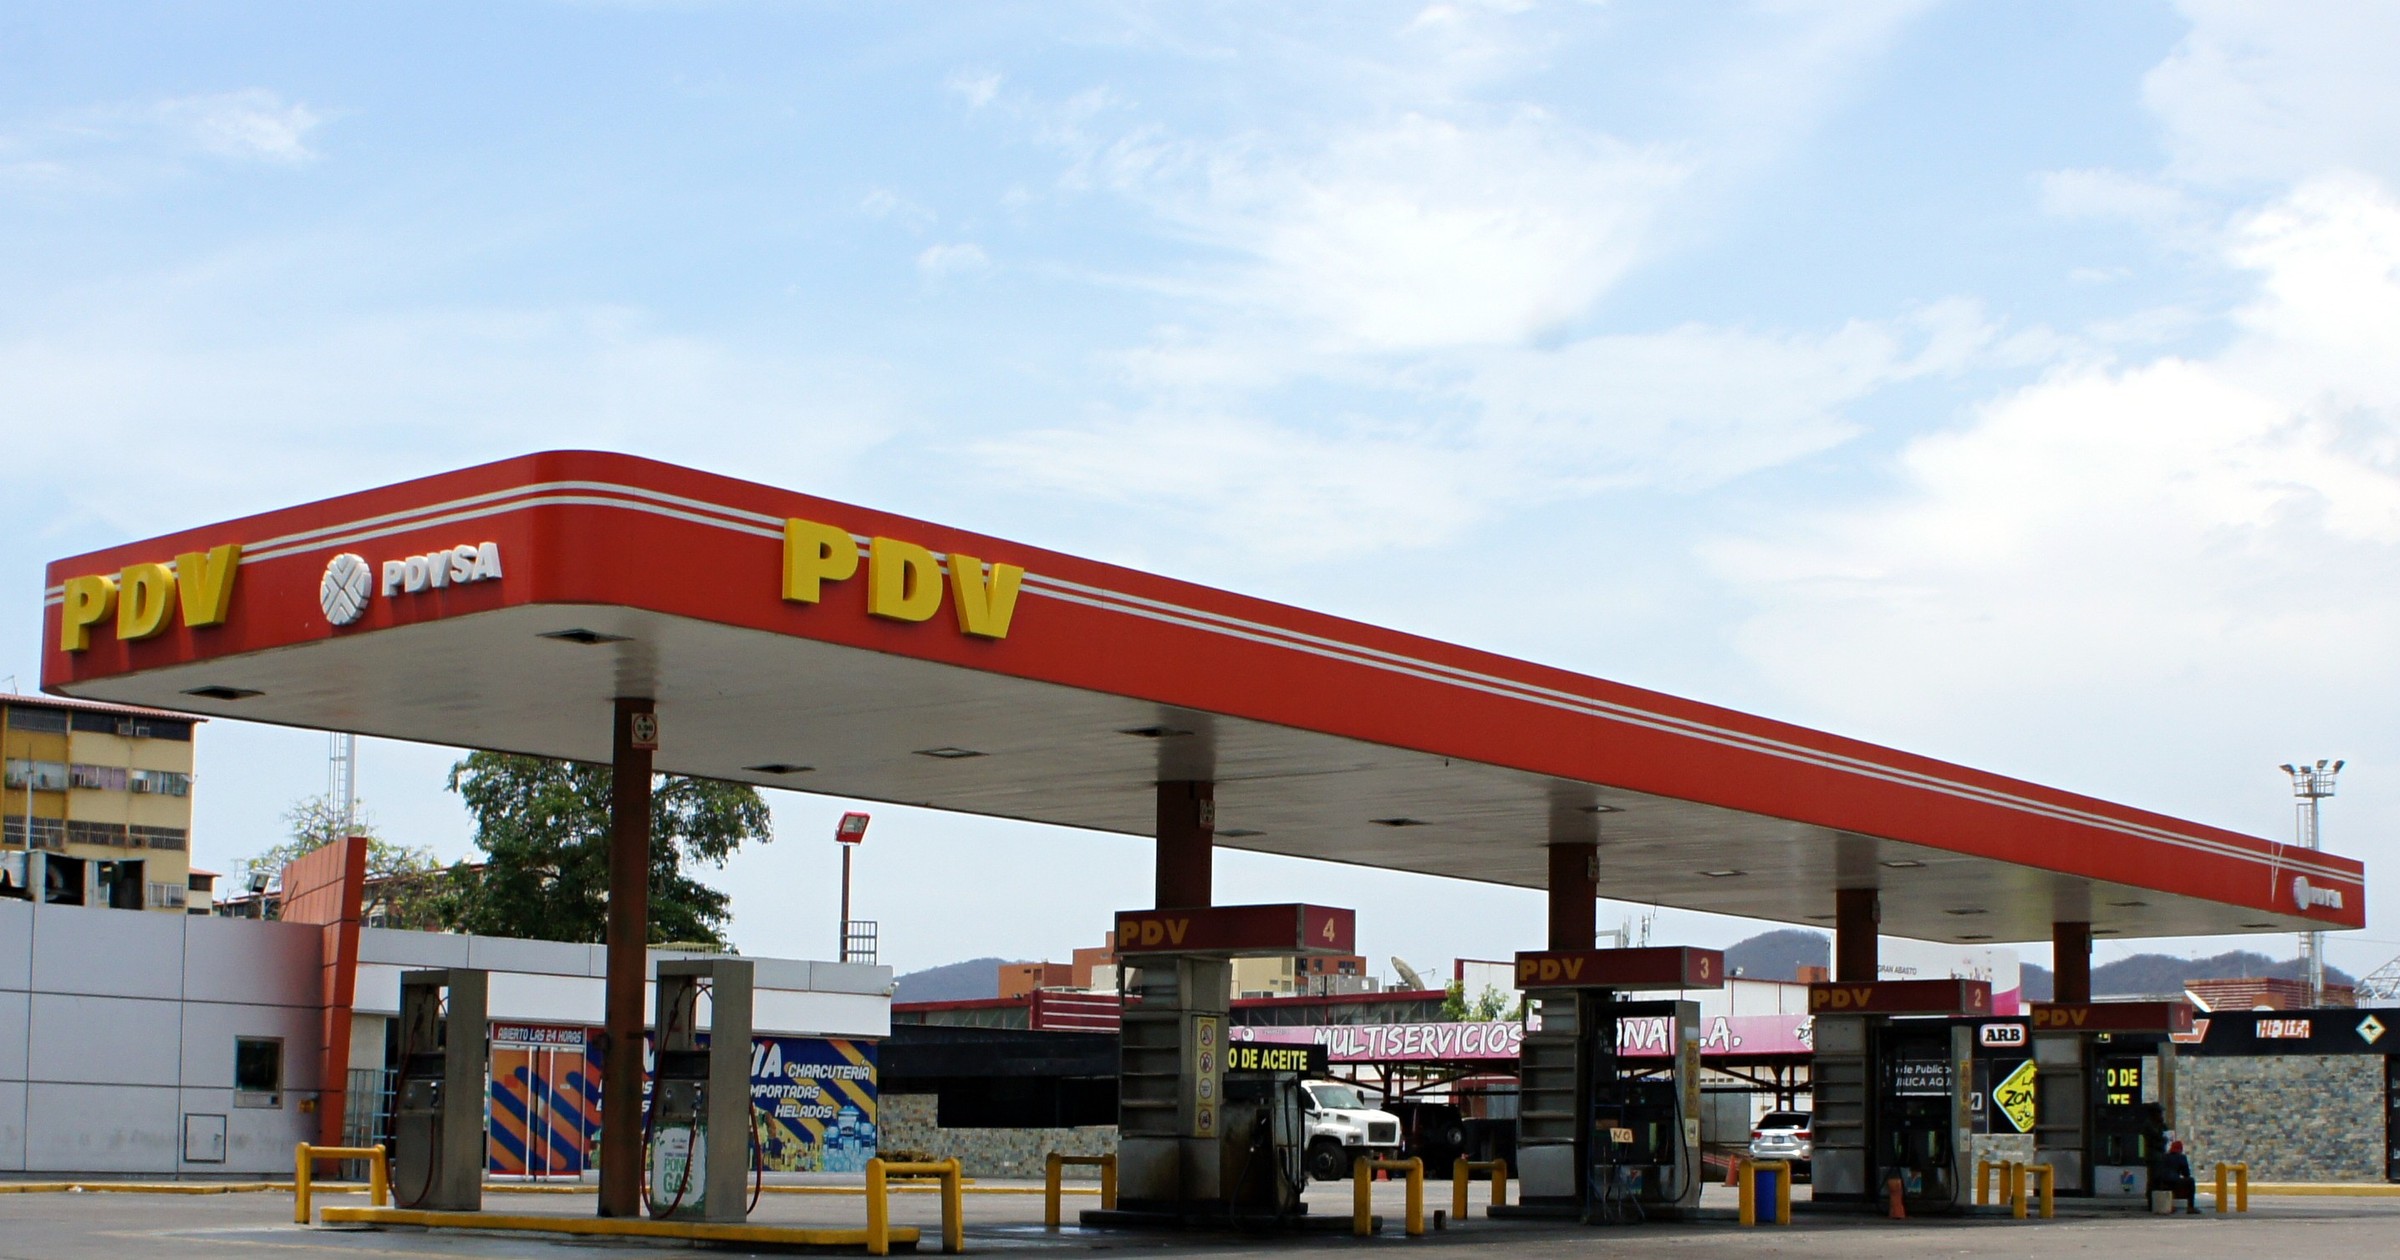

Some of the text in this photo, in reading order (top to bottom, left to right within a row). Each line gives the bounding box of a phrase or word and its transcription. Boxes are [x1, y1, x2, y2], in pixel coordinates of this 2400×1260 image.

[382, 541, 502, 597] PDVSA
[783, 518, 1024, 638] PDV
[61, 544, 242, 651] PDV
[1119, 918, 1190, 947] PDV
[1322, 917, 1336, 942] 4
[1519, 957, 1584, 981] PDV
[1700, 957, 1709, 979] 3
[1812, 988, 1873, 1009] PDV
[1974, 988, 1982, 1008] 2
[2033, 1009, 2088, 1027] PDV
[498, 1027, 529, 1041] ABIERTO
[529, 1028, 545, 1042] LAS
[558, 1030, 582, 1043] HORAS
[1313, 1023, 1522, 1059] MULTISERVICIOS
[1985, 1028, 2021, 1042] ARB
[1241, 1049, 1258, 1069] DE
[1261, 1050, 1308, 1071] ACEITE
[2120, 1068, 2138, 1087] DE
[751, 1084, 820, 1099] MPORTADAS
[2004, 1090, 2034, 1107] ZON
[775, 1105, 833, 1119] HELADOS
